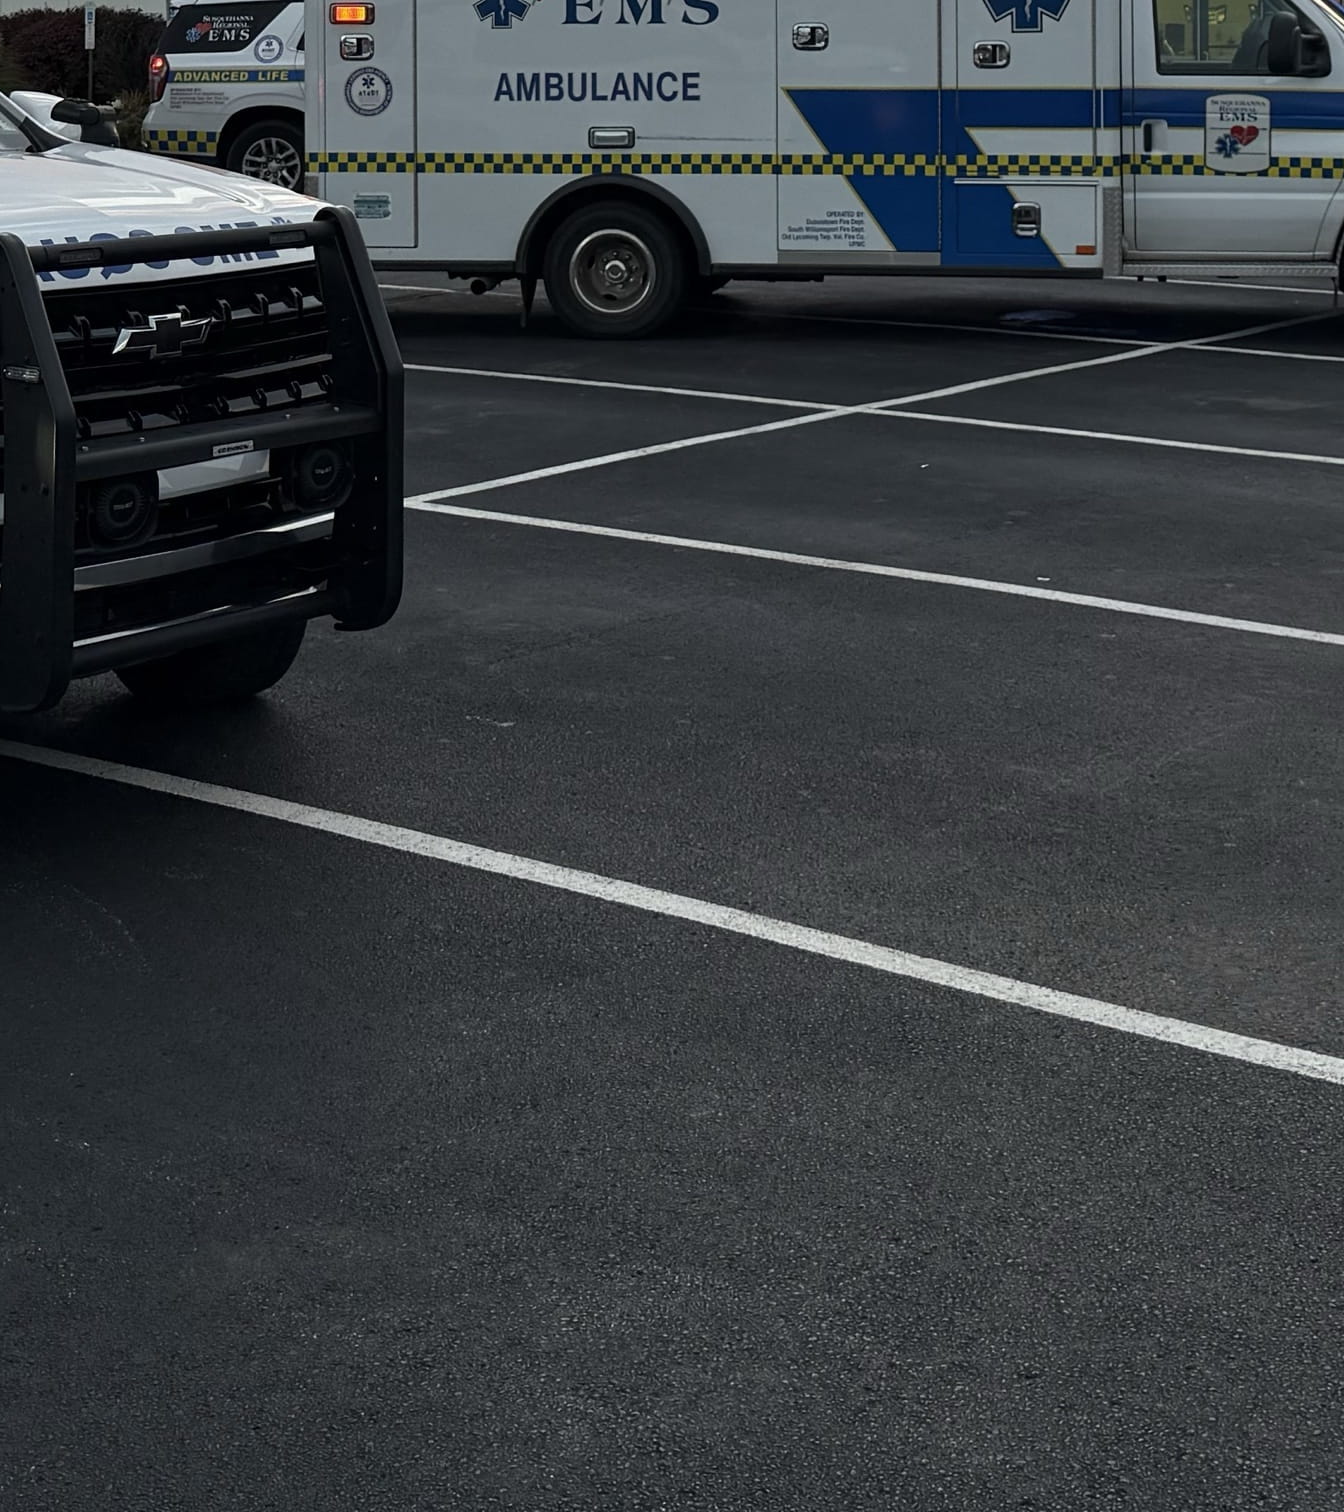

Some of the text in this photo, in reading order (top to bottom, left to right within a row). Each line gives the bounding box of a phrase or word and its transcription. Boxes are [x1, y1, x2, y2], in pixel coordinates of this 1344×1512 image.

[208, 29, 251, 42] EMS
[173, 71, 289, 81] ADVANCED LIFE
[494, 71, 701, 102] AMBULANCE
[1219, 112, 1258, 122] EMS
